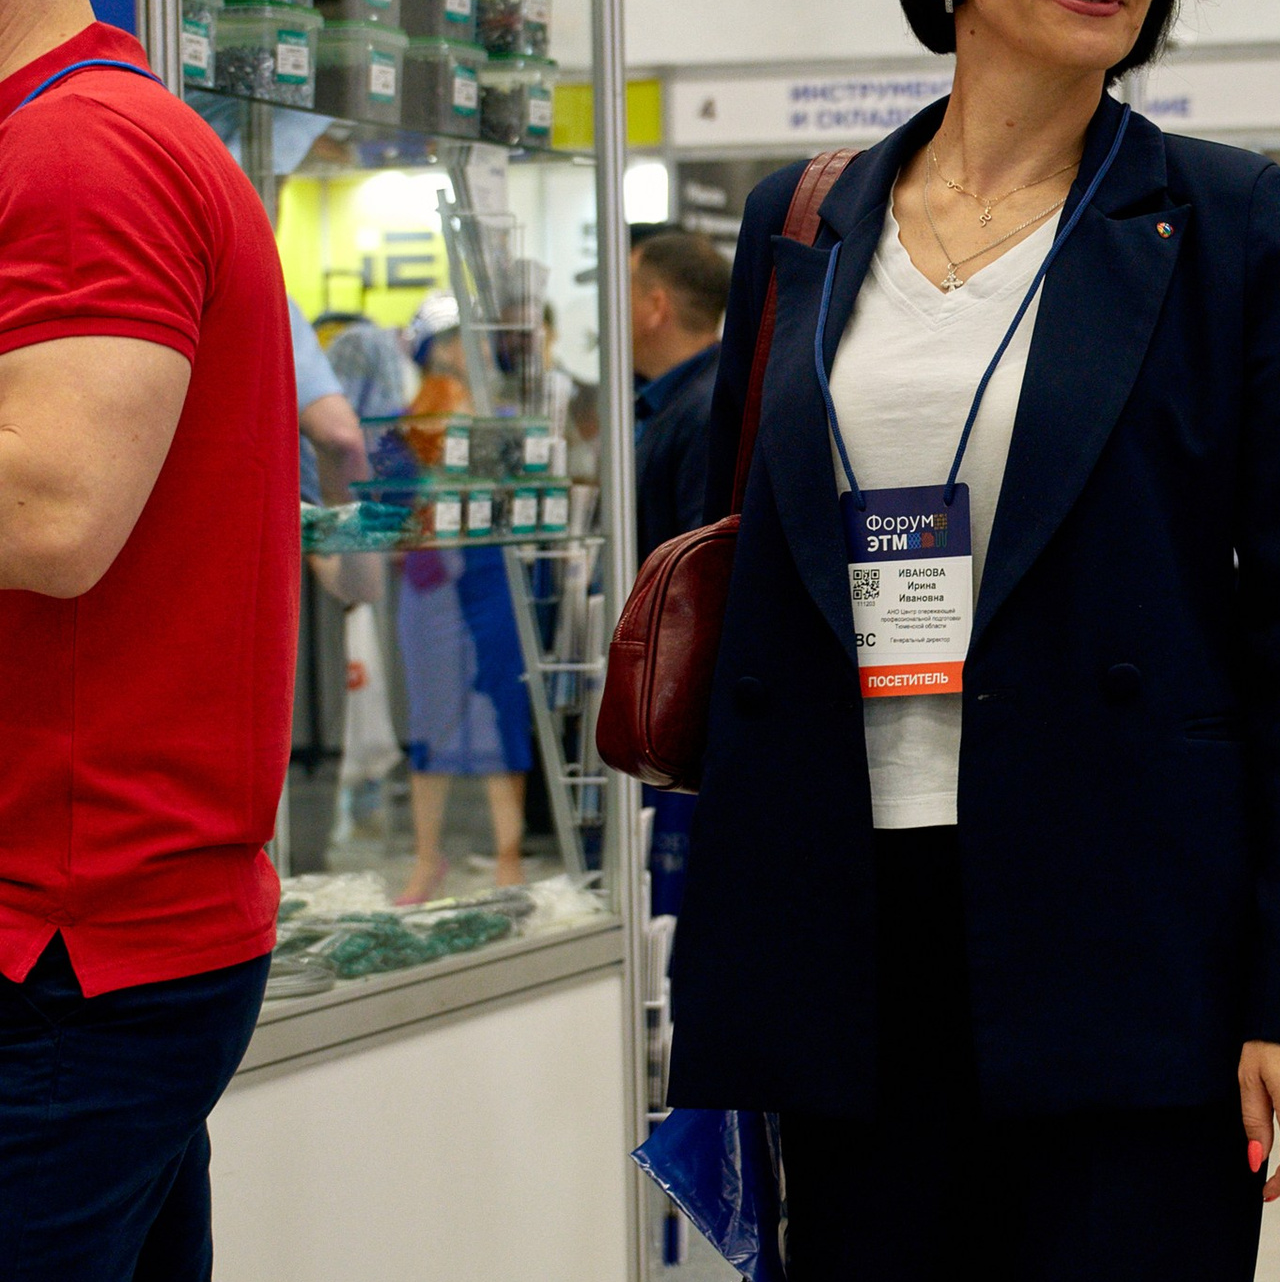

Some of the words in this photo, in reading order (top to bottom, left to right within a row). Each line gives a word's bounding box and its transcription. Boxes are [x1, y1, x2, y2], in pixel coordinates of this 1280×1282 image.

[866, 513, 934, 534] Форум
[866, 533, 908, 552] ЭТМ
[898, 567, 946, 578] ИВАНОВА
[907, 581, 937, 592] Ирина
[898, 593, 945, 603] Ивановна
[868, 671, 949, 689] ПОСЕТИТЕЛЬ
